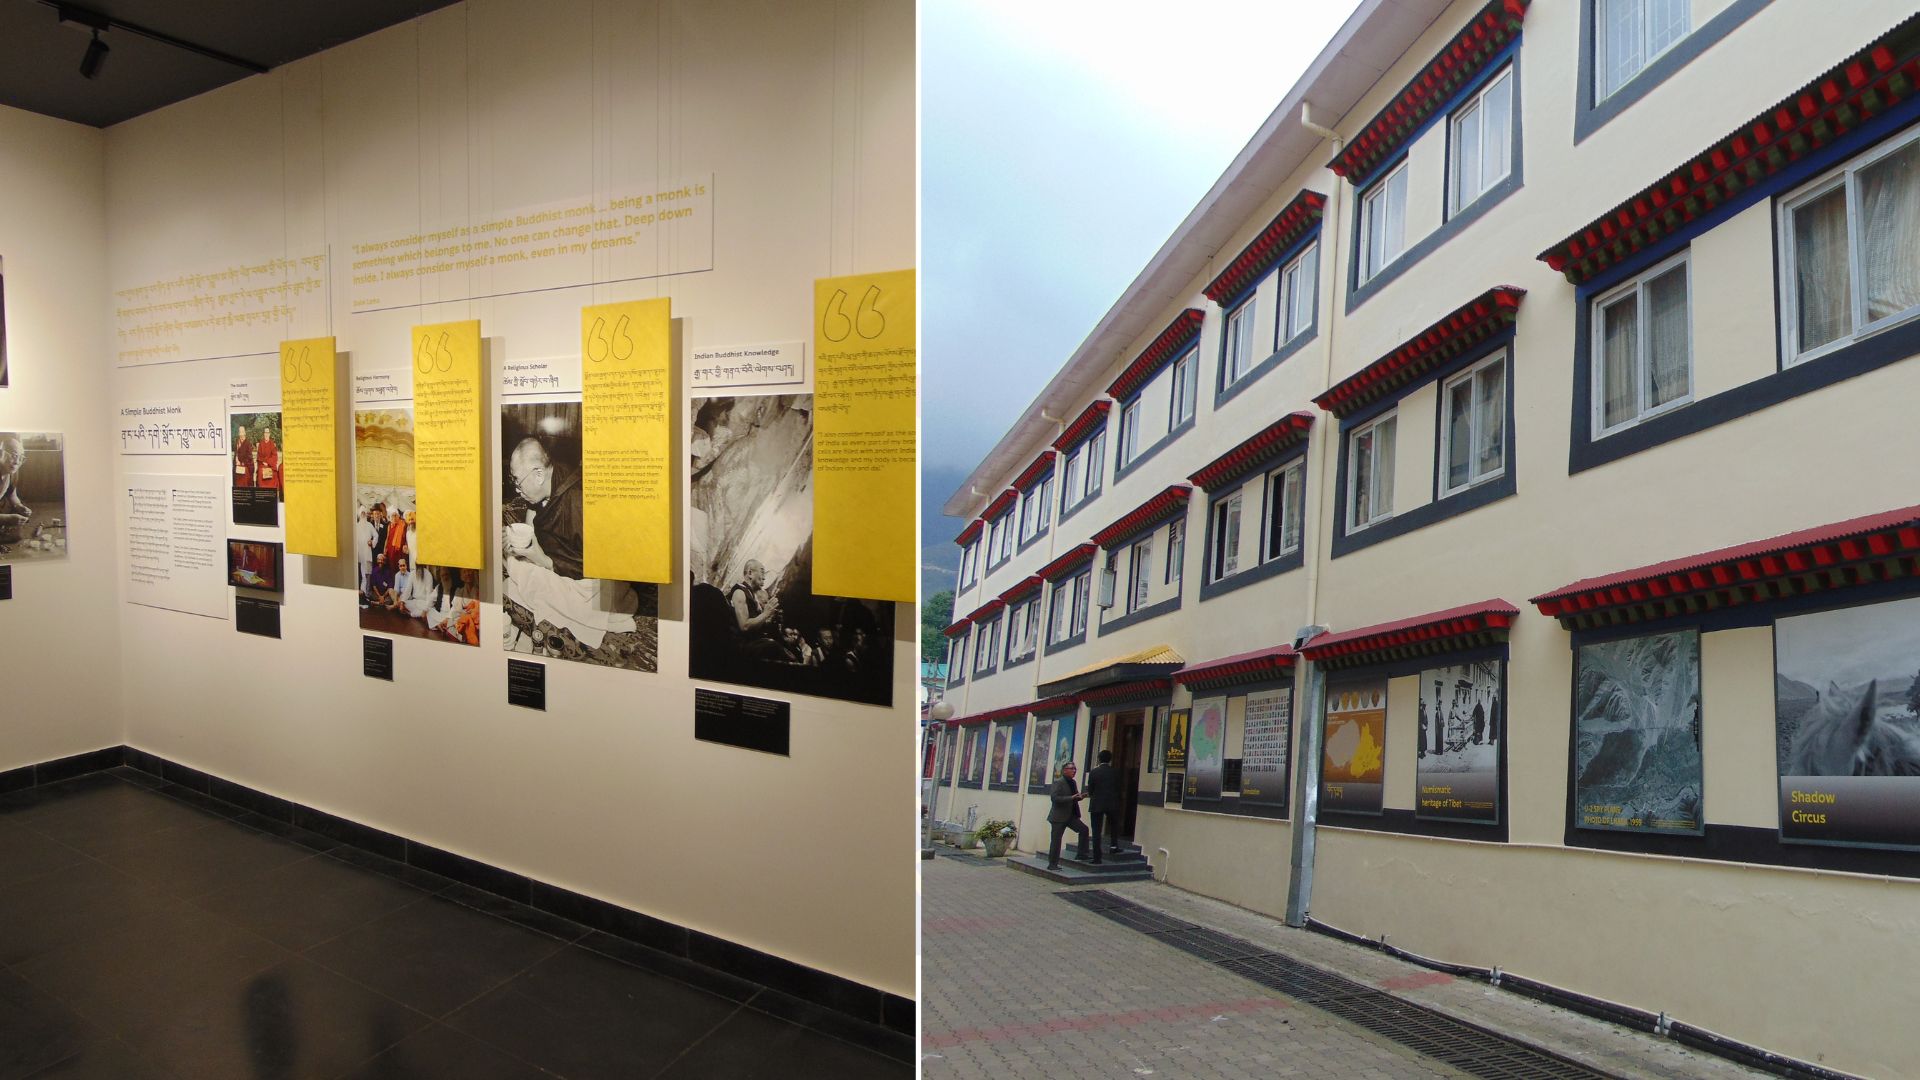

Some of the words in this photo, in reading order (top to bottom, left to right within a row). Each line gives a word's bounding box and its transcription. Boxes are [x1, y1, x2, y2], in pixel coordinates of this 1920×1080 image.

[361, 241, 388, 255] always
[390, 235, 425, 249] consider
[428, 229, 458, 243] myself
[460, 227, 470, 237] as
[472, 226, 479, 234] a
[481, 220, 513, 233] simple
[516, 209, 562, 227] Buddhist
[565, 204, 596, 217] monk
[610, 196, 642, 210] being
[646, 194, 653, 204] a
[656, 186, 692, 202] monk
[695, 183, 705, 195] is
[352, 255, 395, 271] something
[397, 248, 422, 263] which
[424, 246, 460, 260] belongs
[462, 243, 471, 253] to
[494, 236, 508, 247] No
[511, 233, 529, 244] one
[532, 230, 550, 241] can
[553, 223, 591, 238] change
[625, 213, 655, 227] Deep
[658, 206, 692, 221] down
[380, 271, 384, 281] I
[386, 267, 414, 281] always
[416, 261, 453, 276] consider
[456, 255, 487, 271] myself
[489, 256, 495, 265] a
[531, 246, 555, 259] even
[558, 244, 568, 255] in
[570, 242, 588, 255] my
[715, 351, 743, 359] Buddhist
[744, 349, 779, 357] Knowledge
[125, 408, 143, 418] Simple
[143, 407, 166, 416] Buddhist
[167, 405, 182, 414] Monk
[1422, 784, 1451, 794] Numismatic
[1422, 798, 1442, 809] heritage
[1442, 799, 1448, 807] of
[1449, 799, 1462, 808] Tibet
[1791, 790, 1836, 804] Shadow
[1584, 816, 1601, 824] PHOTO
[1791, 810, 1826, 824] Circus
